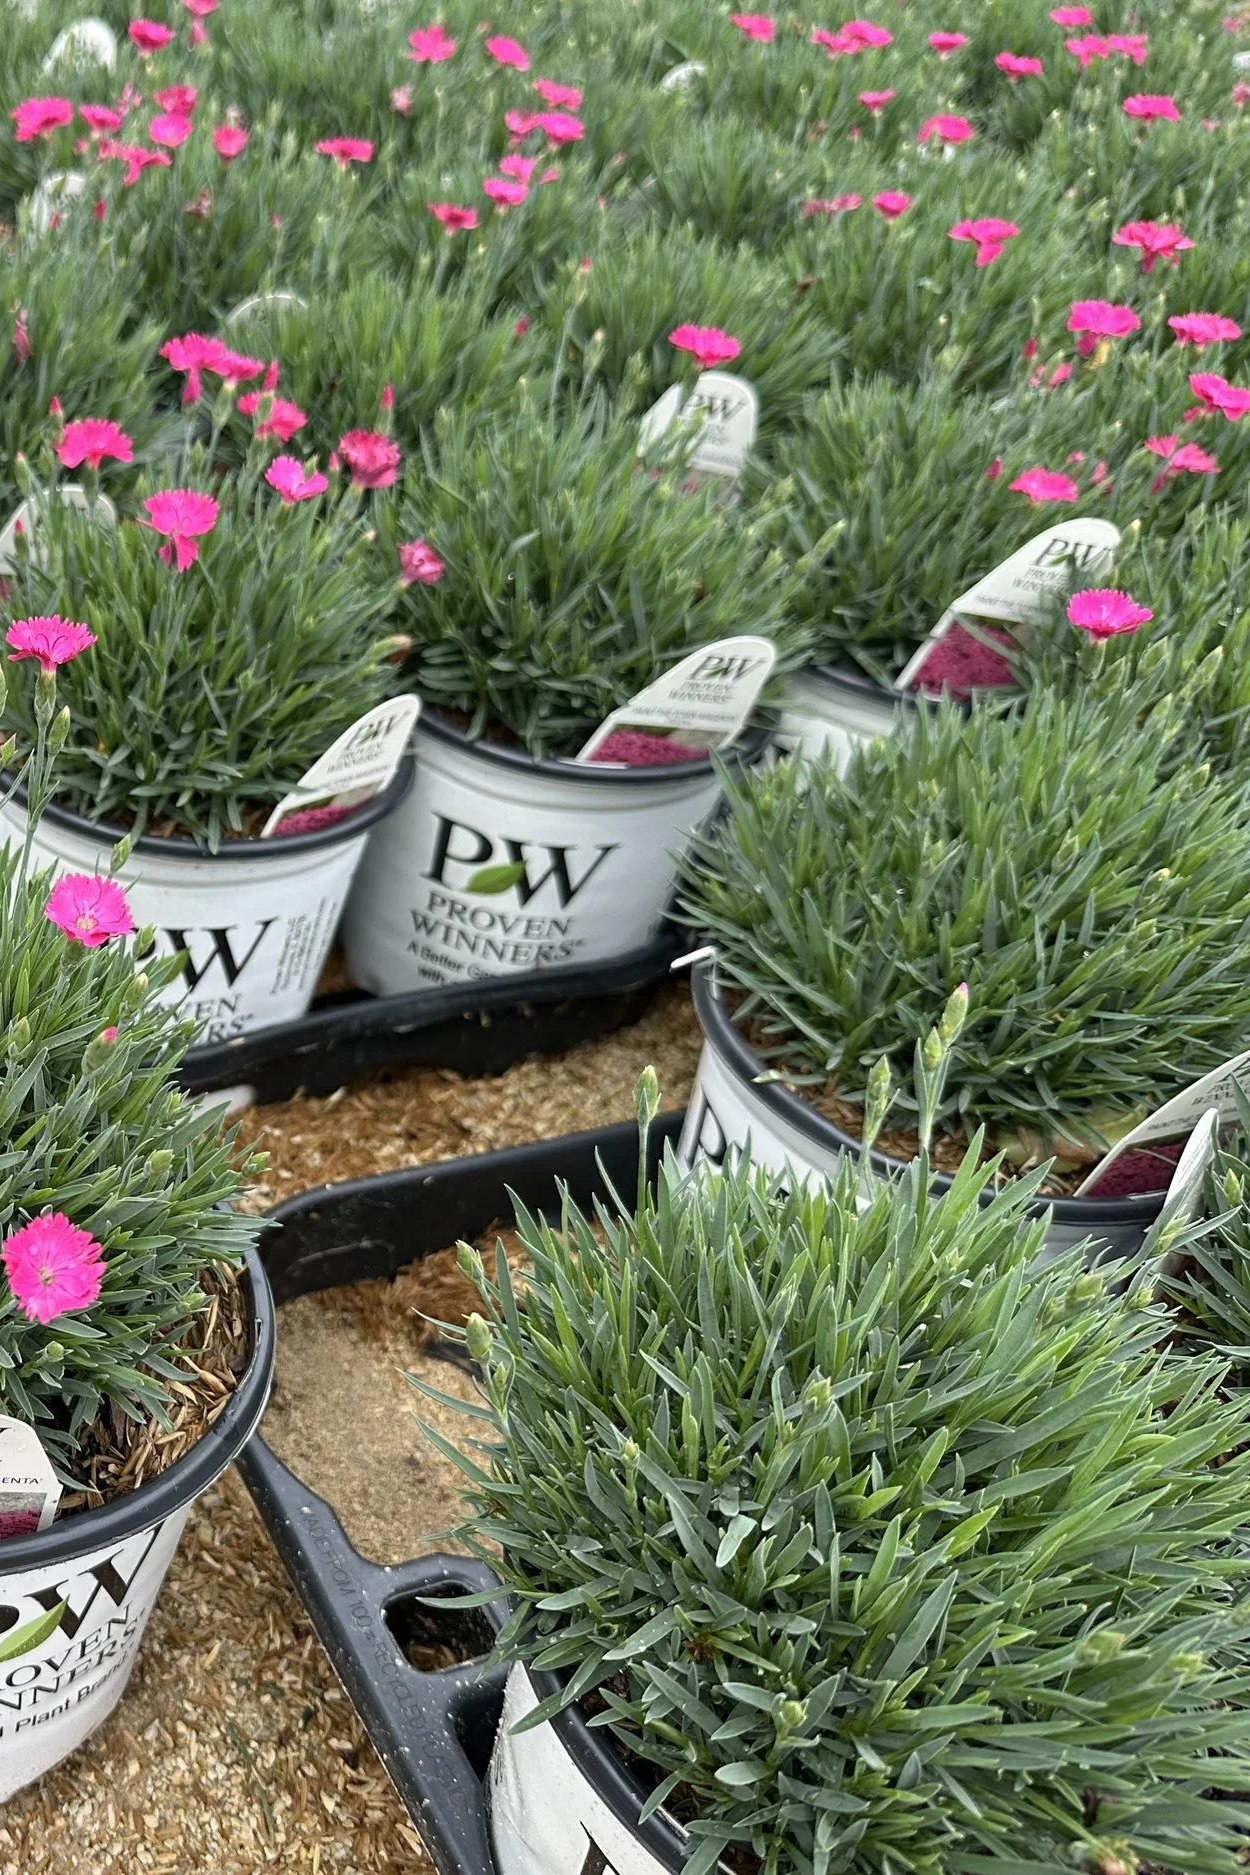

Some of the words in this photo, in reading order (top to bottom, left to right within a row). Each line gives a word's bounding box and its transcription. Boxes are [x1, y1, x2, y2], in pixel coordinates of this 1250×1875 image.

[1032, 538, 1112, 569] PW
[688, 656, 768, 682] PW
[419, 811, 620, 909] PW
[429, 890, 576, 937] PROVEN
[134, 914, 280, 993] W
[15, 1697, 70, 1733] Plant
[77, 1651, 128, 1704] Brand
